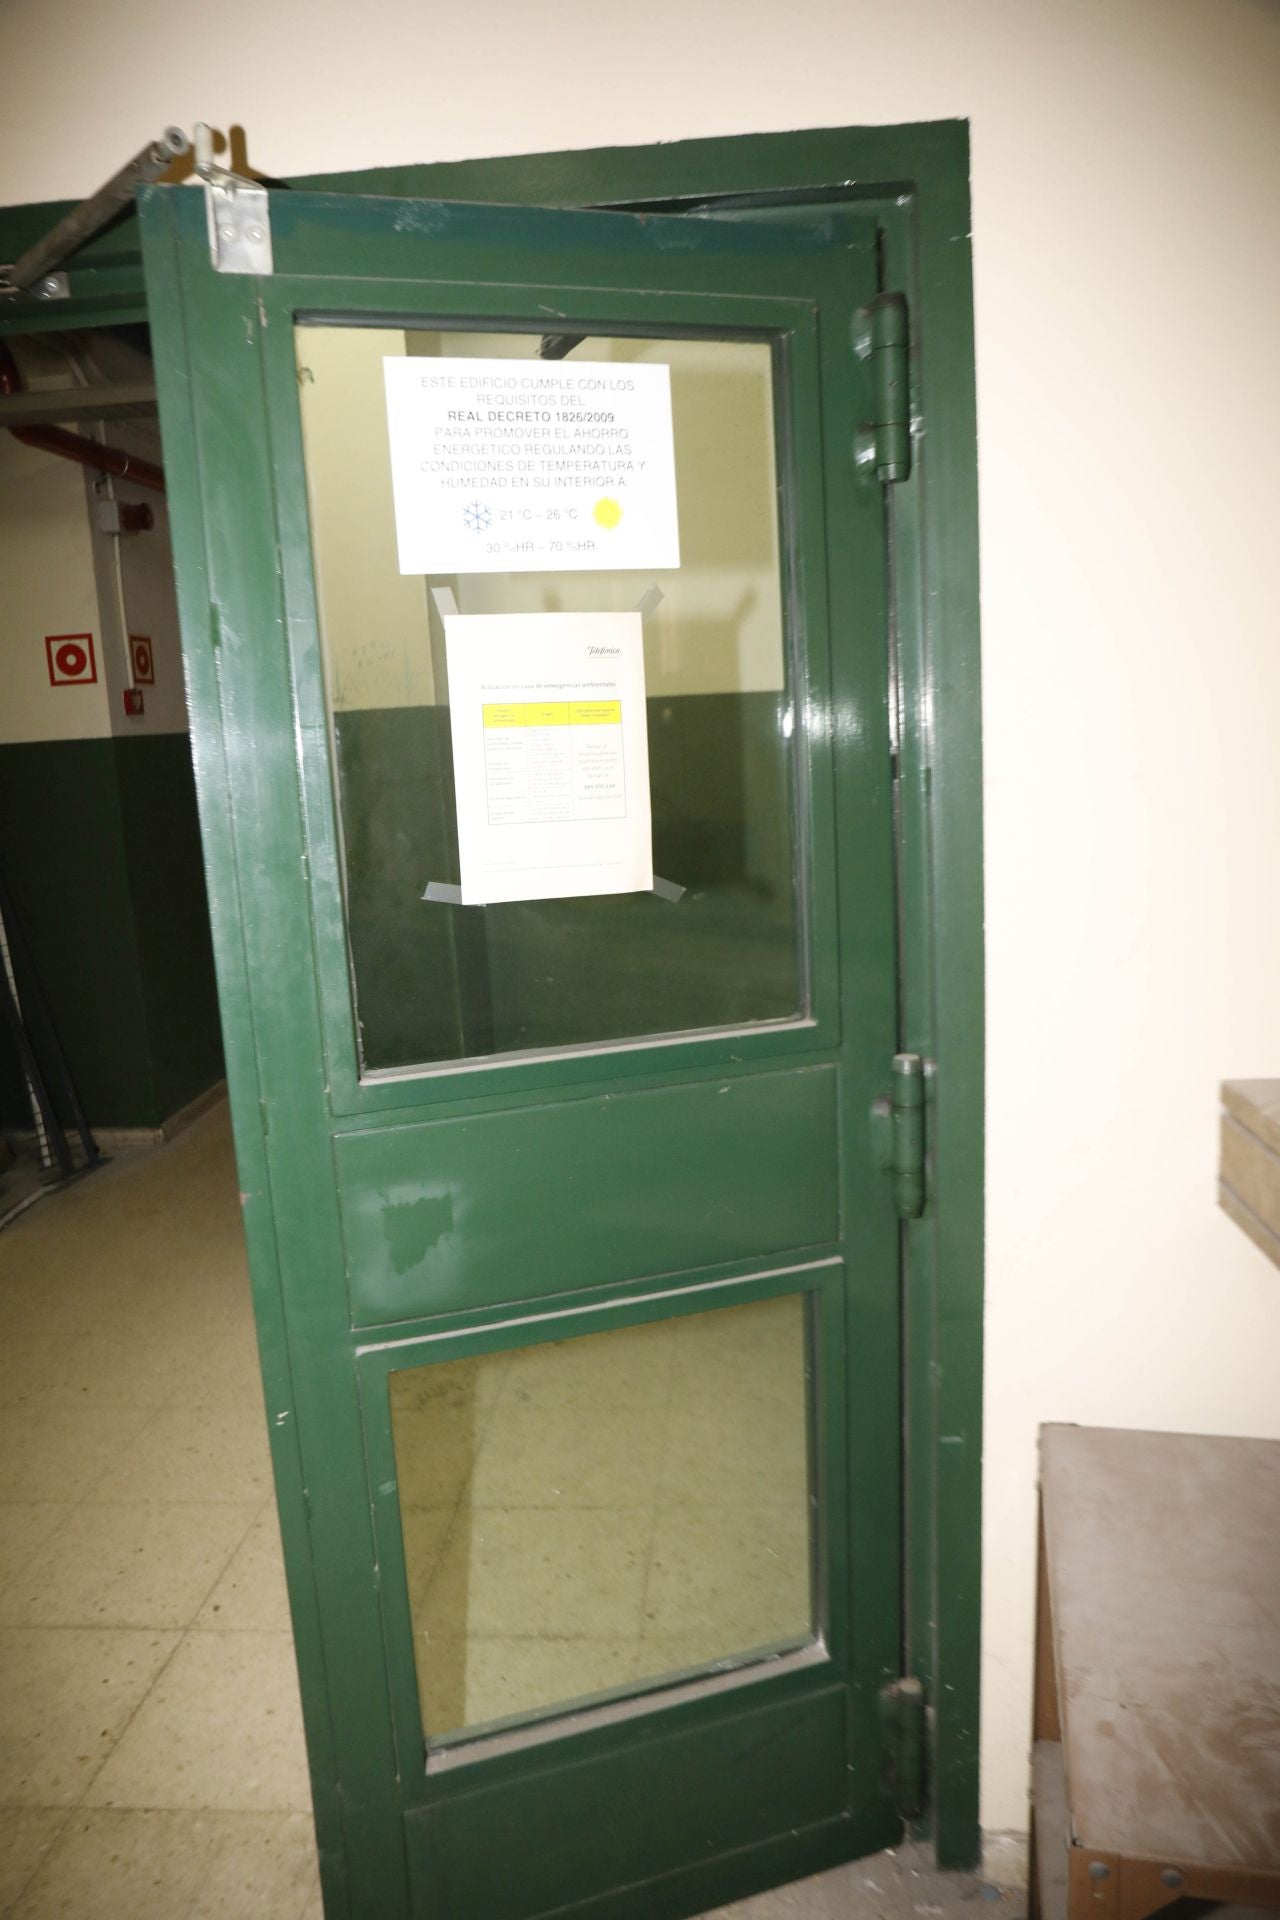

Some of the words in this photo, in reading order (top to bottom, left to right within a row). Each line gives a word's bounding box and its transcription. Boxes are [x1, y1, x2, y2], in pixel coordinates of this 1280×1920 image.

[420, 376, 456, 388] ESTE
[460, 377, 518, 390] EDIFICIO
[520, 377, 574, 390] CUMPLE
[577, 378, 606, 391] CON
[609, 378, 636, 391] LOS
[476, 394, 558, 406] REQUISITOS
[560, 395, 585, 406] DEL
[448, 411, 483, 422] REAL
[487, 411, 551, 423] DECRETO
[555, 411, 615, 423] 1826/2009
[434, 427, 471, 439] PARA
[475, 427, 552, 439] PROMOVER
[554, 427, 571, 439] EL
[573, 427, 629, 440] AHORRO
[524, 444, 606, 455] REGULANDO
[608, 443, 633, 455] LAS
[419, 460, 514, 473] CONDICIONES
[517, 460, 536, 472] DE
[539, 460, 635, 472] TEMPERATURA
[440, 477, 508, 489] HUMEDAD
[511, 477, 529, 488] EN
[532, 477, 551, 488] SU
[554, 476, 615, 487] INTERIOR
[499, 509, 514, 521] 21
[545, 508, 561, 520] 26
[486, 542, 500, 554] 30
[548, 541, 563, 552] 70
